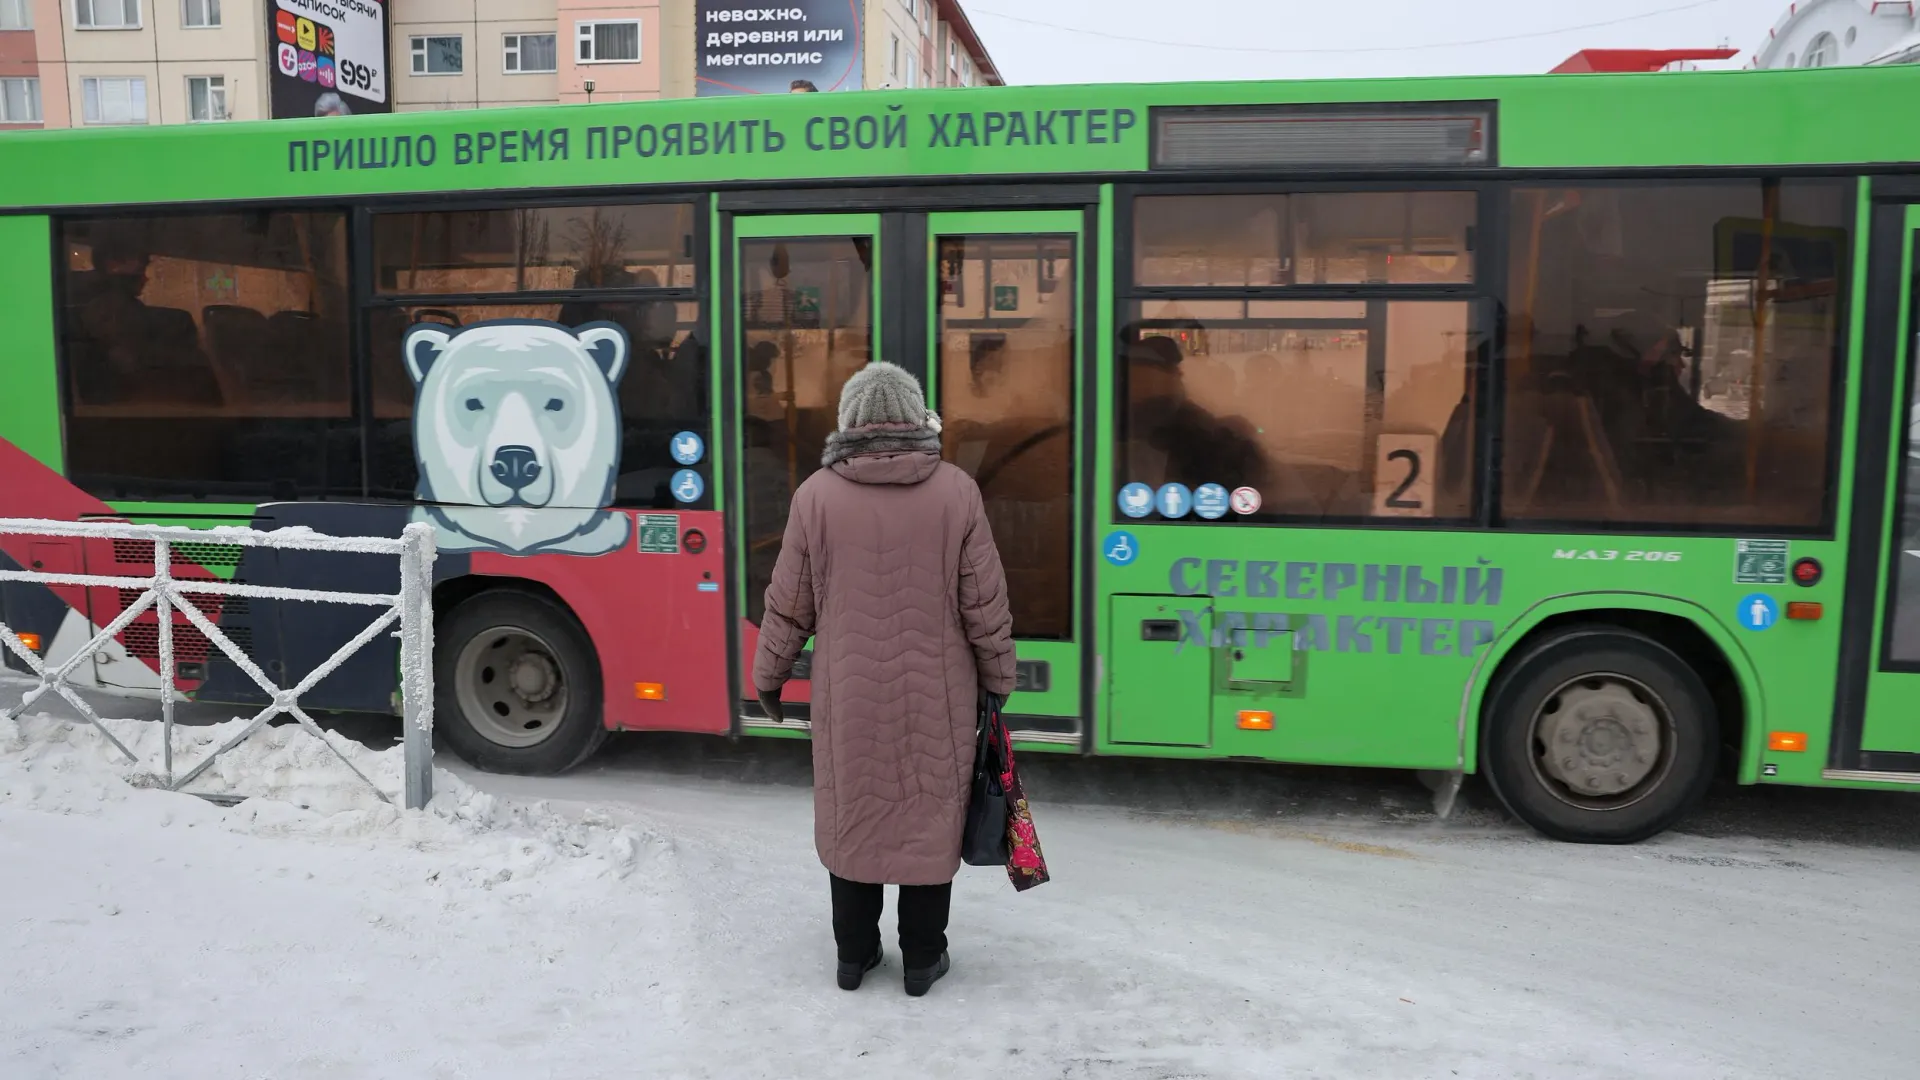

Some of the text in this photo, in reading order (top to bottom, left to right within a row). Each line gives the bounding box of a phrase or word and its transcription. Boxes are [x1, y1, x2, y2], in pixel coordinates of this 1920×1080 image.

[287, 0, 346, 22] ДПИСОК
[705, 7, 807, 23] неважно,
[705, 28, 844, 47] деревня или
[705, 51, 823, 67] мегаполис
[288, 104, 1137, 173] ПРИШЛО ВРЕМЯ ПРОЯВИТЬ СВОЙ ХАРАКТЕР
[1384, 448, 1423, 510] 2
[1623, 550, 1683, 562] 206
[1168, 555, 1505, 607] СЕВЕРНЫЙ
[1173, 605, 1496, 658] ХАРАКТЕР
